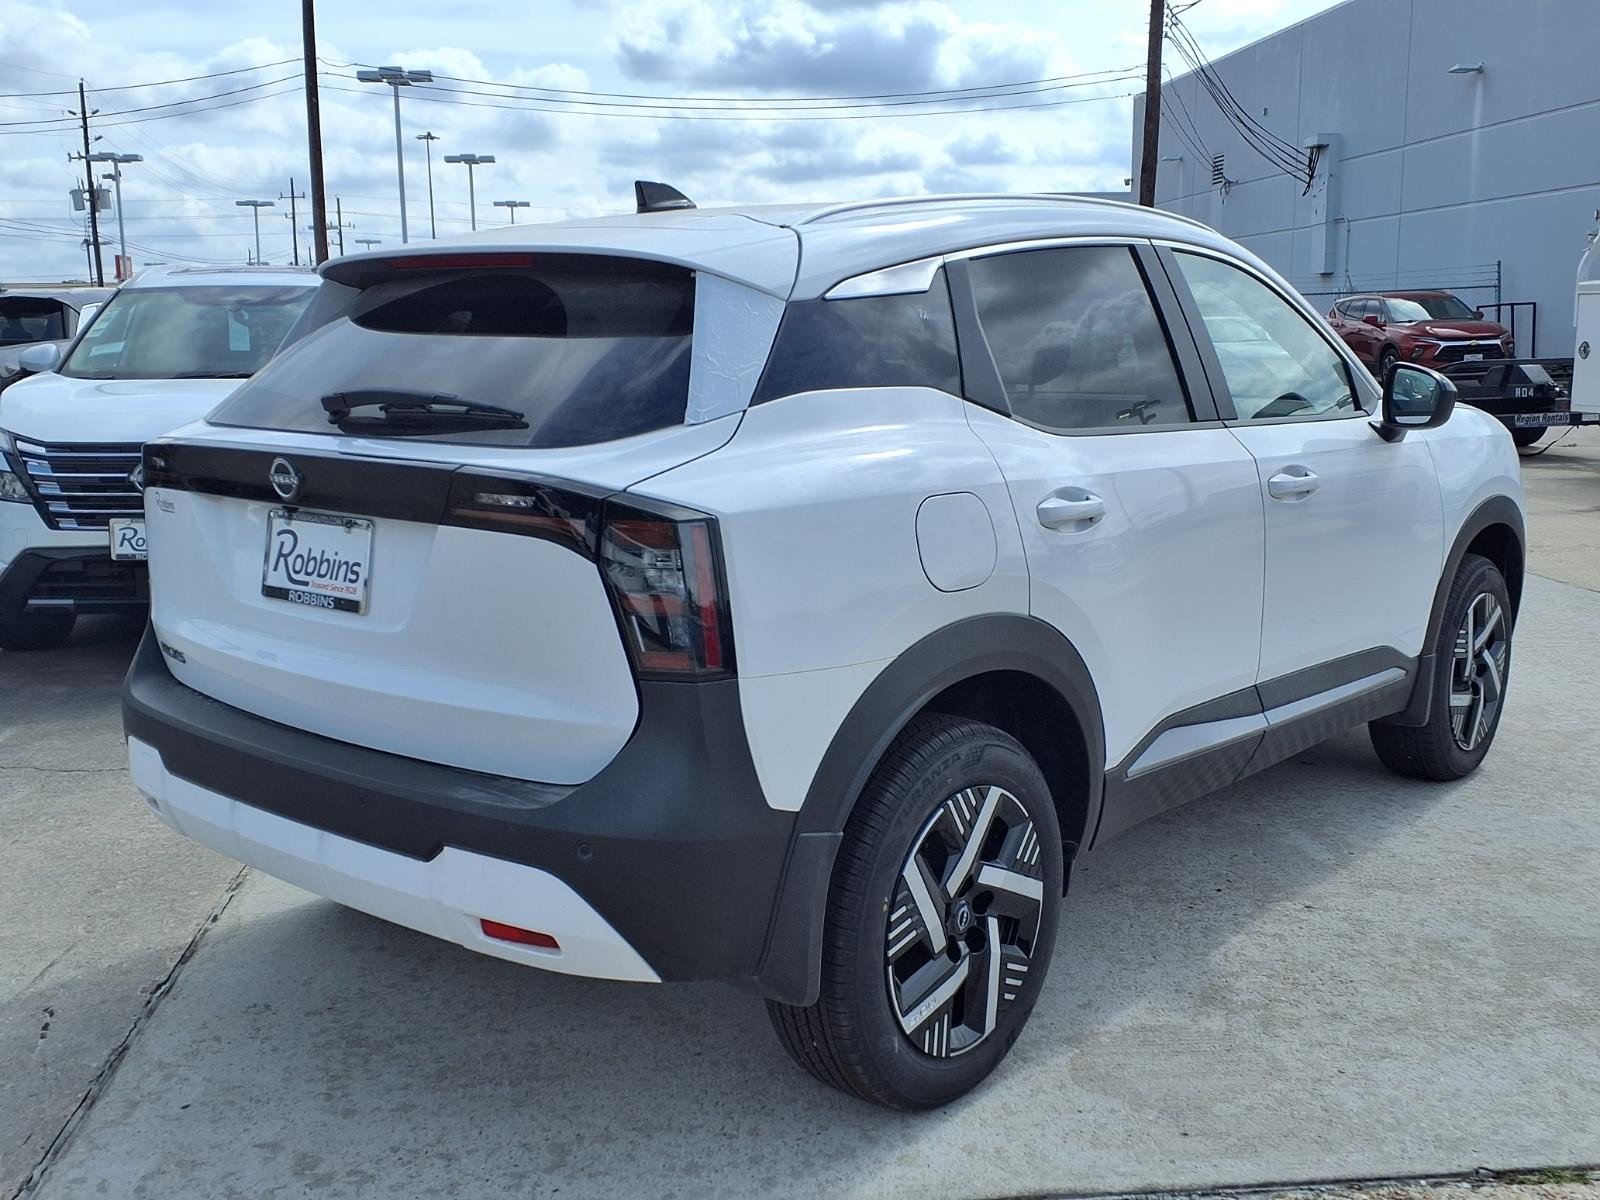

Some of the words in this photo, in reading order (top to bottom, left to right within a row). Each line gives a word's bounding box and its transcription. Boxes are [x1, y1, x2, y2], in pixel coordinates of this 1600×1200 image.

[1515, 414, 1541, 425] Region
[1542, 412, 1569, 423] Rentals
[273, 528, 362, 587] Robbins
[288, 590, 335, 609] ROBBINS
